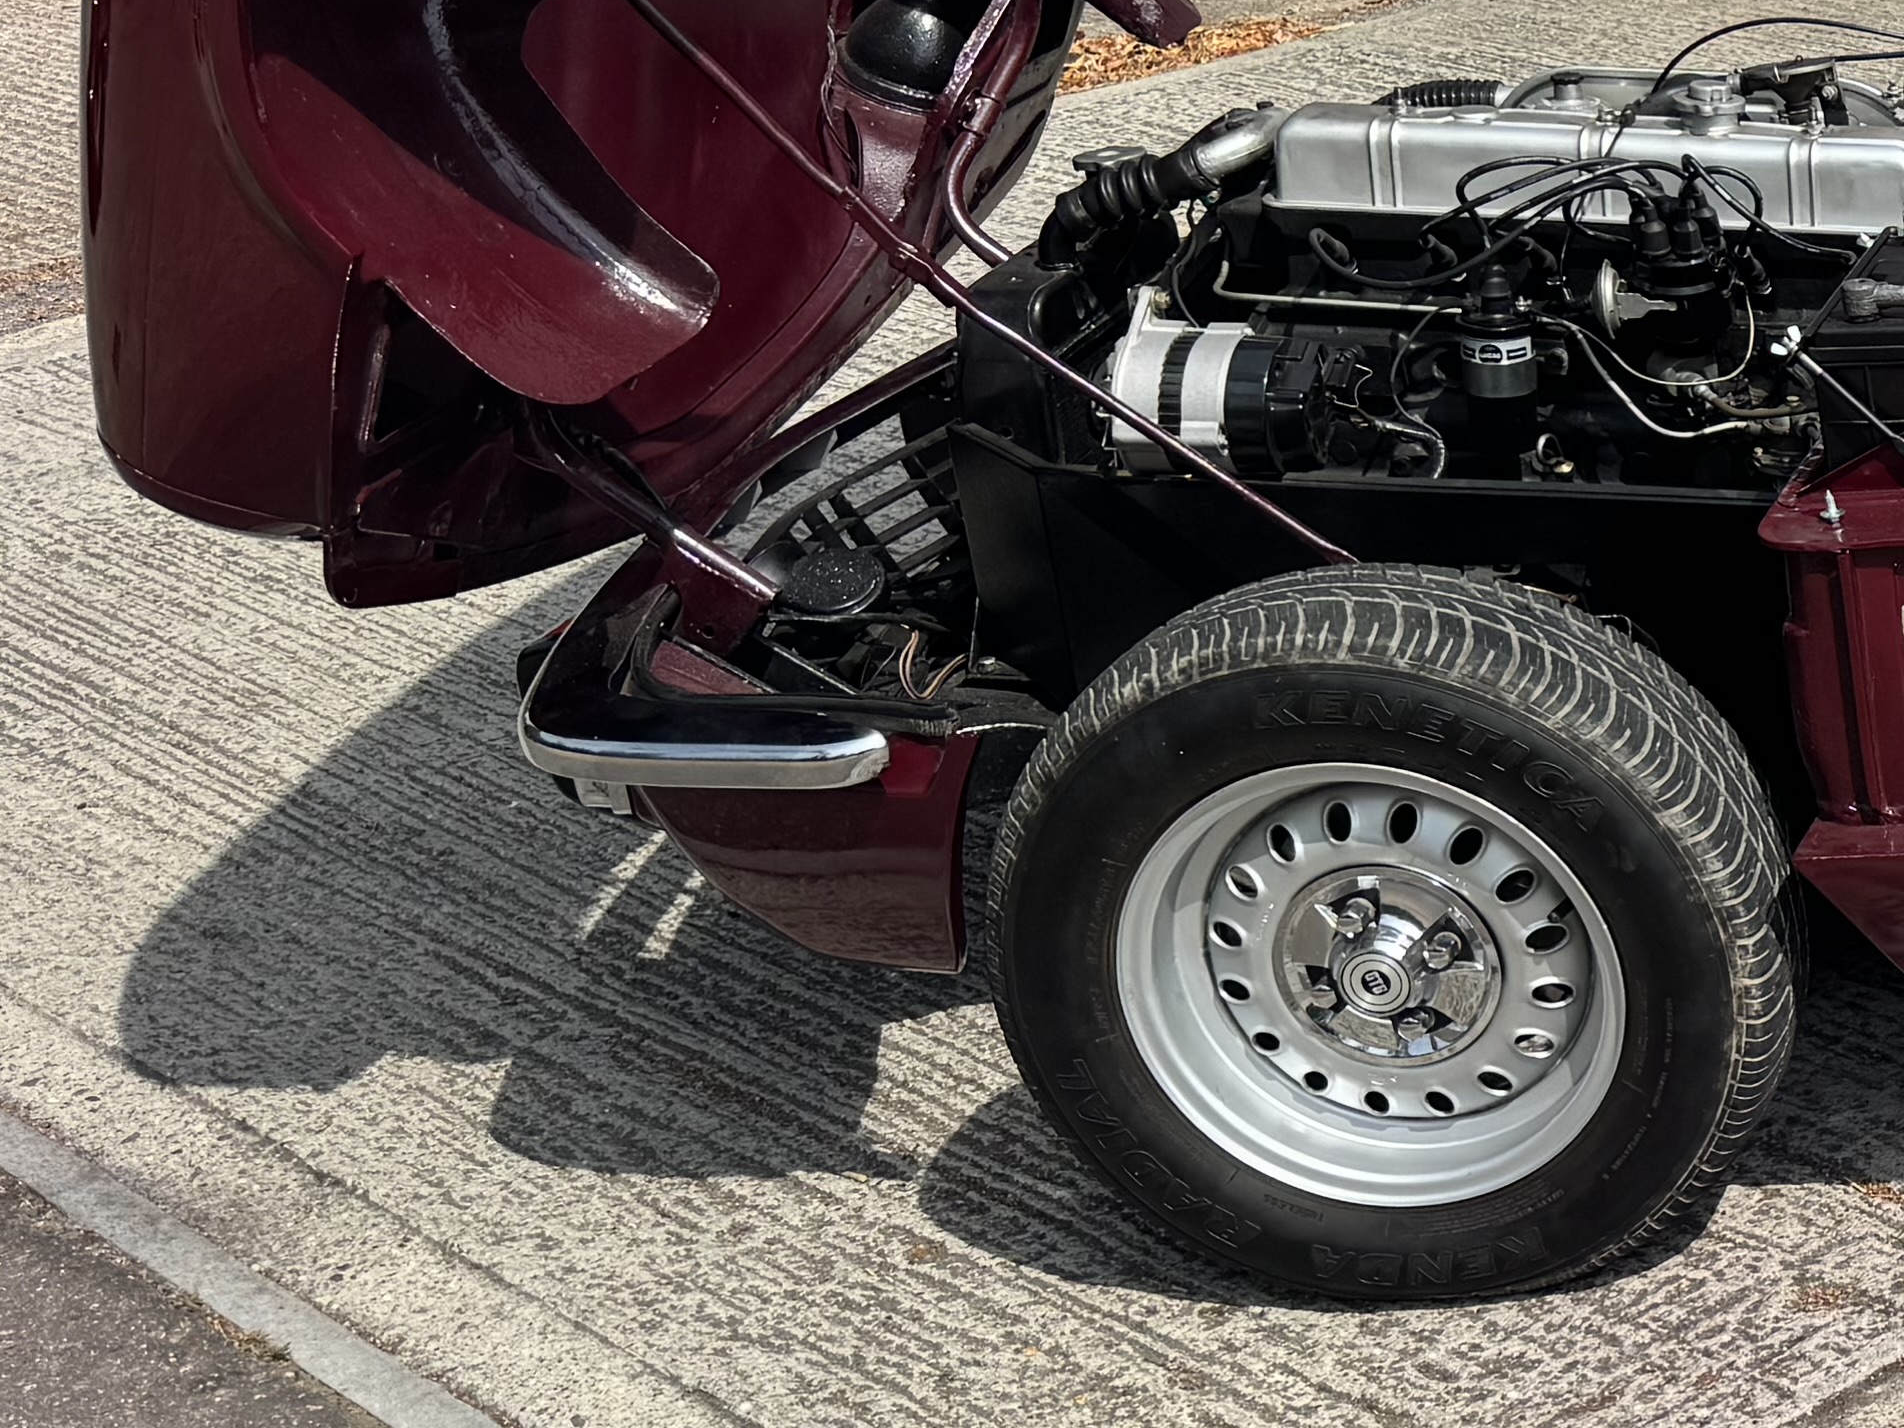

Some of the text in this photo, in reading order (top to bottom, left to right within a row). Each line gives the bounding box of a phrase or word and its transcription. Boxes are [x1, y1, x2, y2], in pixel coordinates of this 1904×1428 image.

[1252, 688, 1608, 832] KENETICA
[1365, 972, 1388, 995] GT6
[1055, 1056, 1557, 1285] KENDA RADIAL
